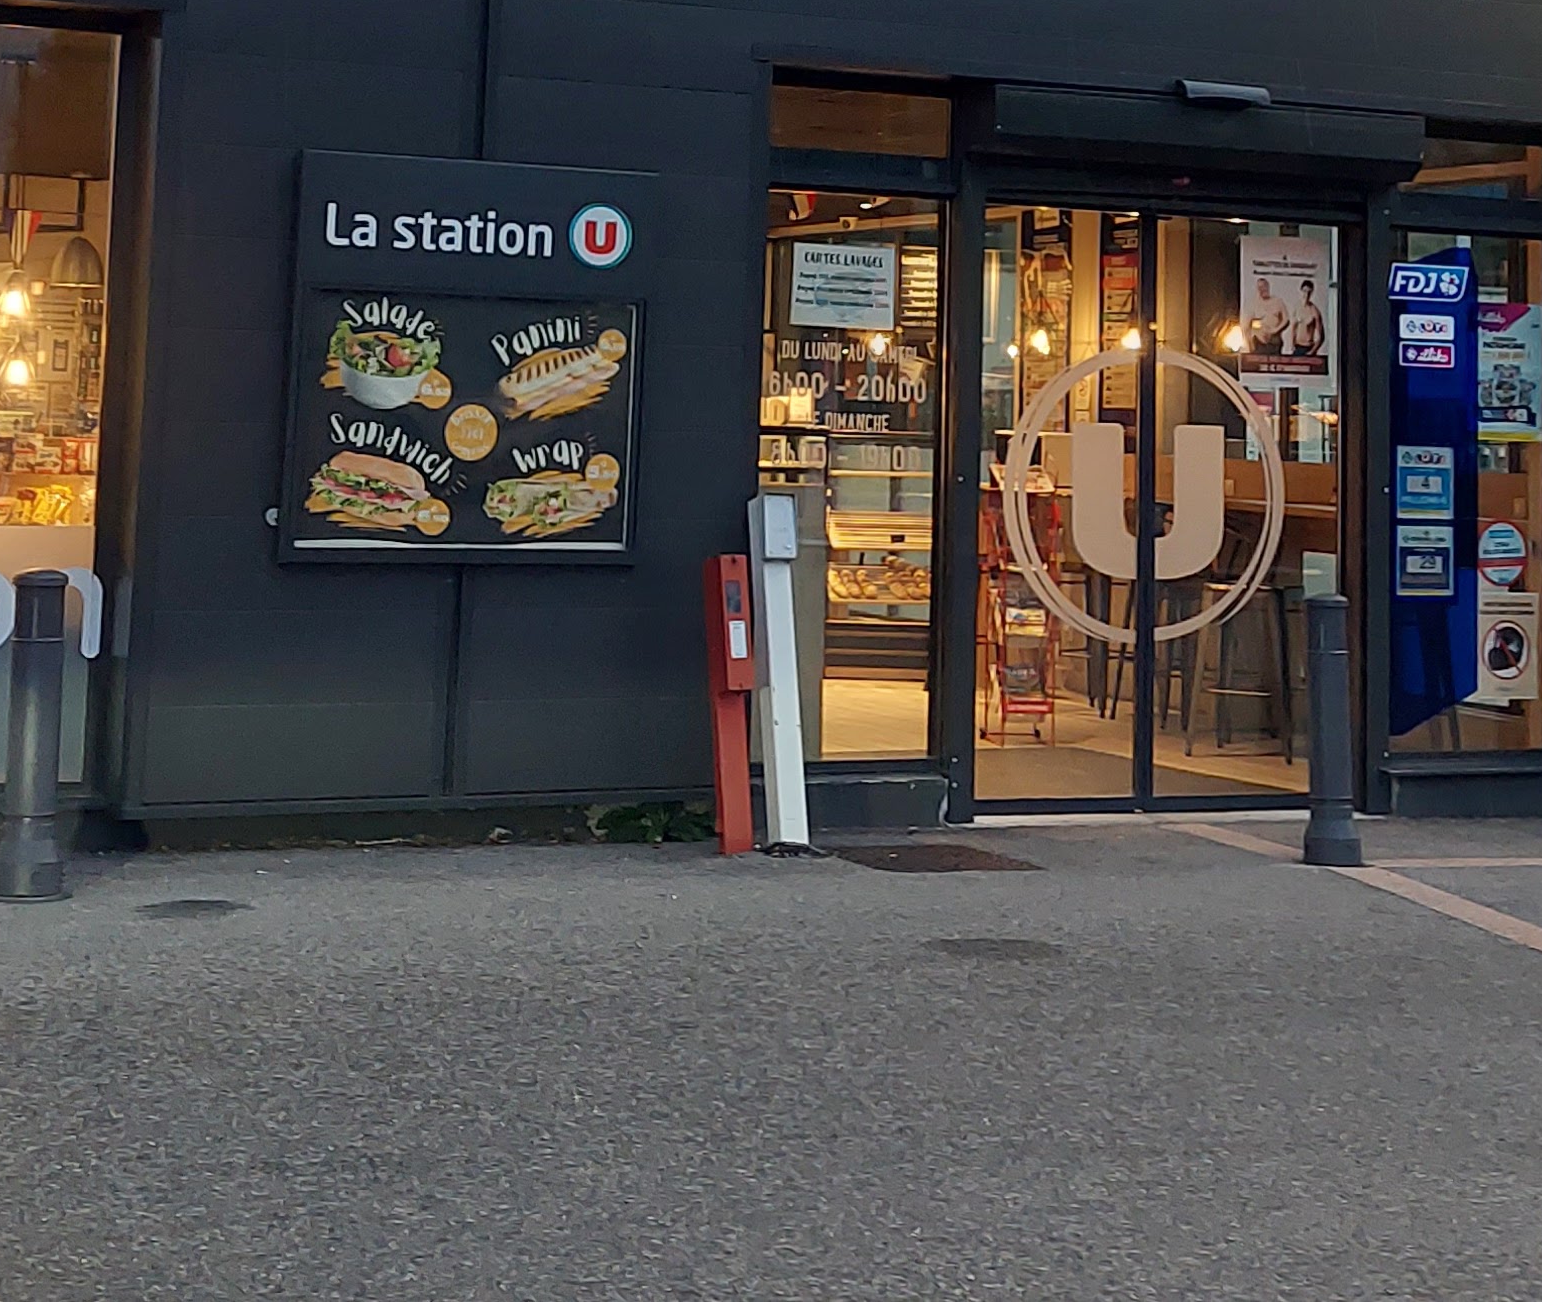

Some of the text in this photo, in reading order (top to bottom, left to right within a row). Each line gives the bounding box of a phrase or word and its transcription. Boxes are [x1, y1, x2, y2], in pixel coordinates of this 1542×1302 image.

[325, 202, 378, 248] La
[392, 210, 554, 258] station
[1393, 270, 1437, 295] FDJ
[342, 297, 437, 342] Salade
[490, 314, 582, 366] Panini
[781, 339, 918, 365] DU LUNDI AU AMDI
[768, 370, 826, 399] 6h00
[856, 369, 927, 404] 20h00
[824, 412, 891, 432] DIMANCHE
[329, 413, 456, 485] Sandwich
[1072, 422, 1224, 580] U
